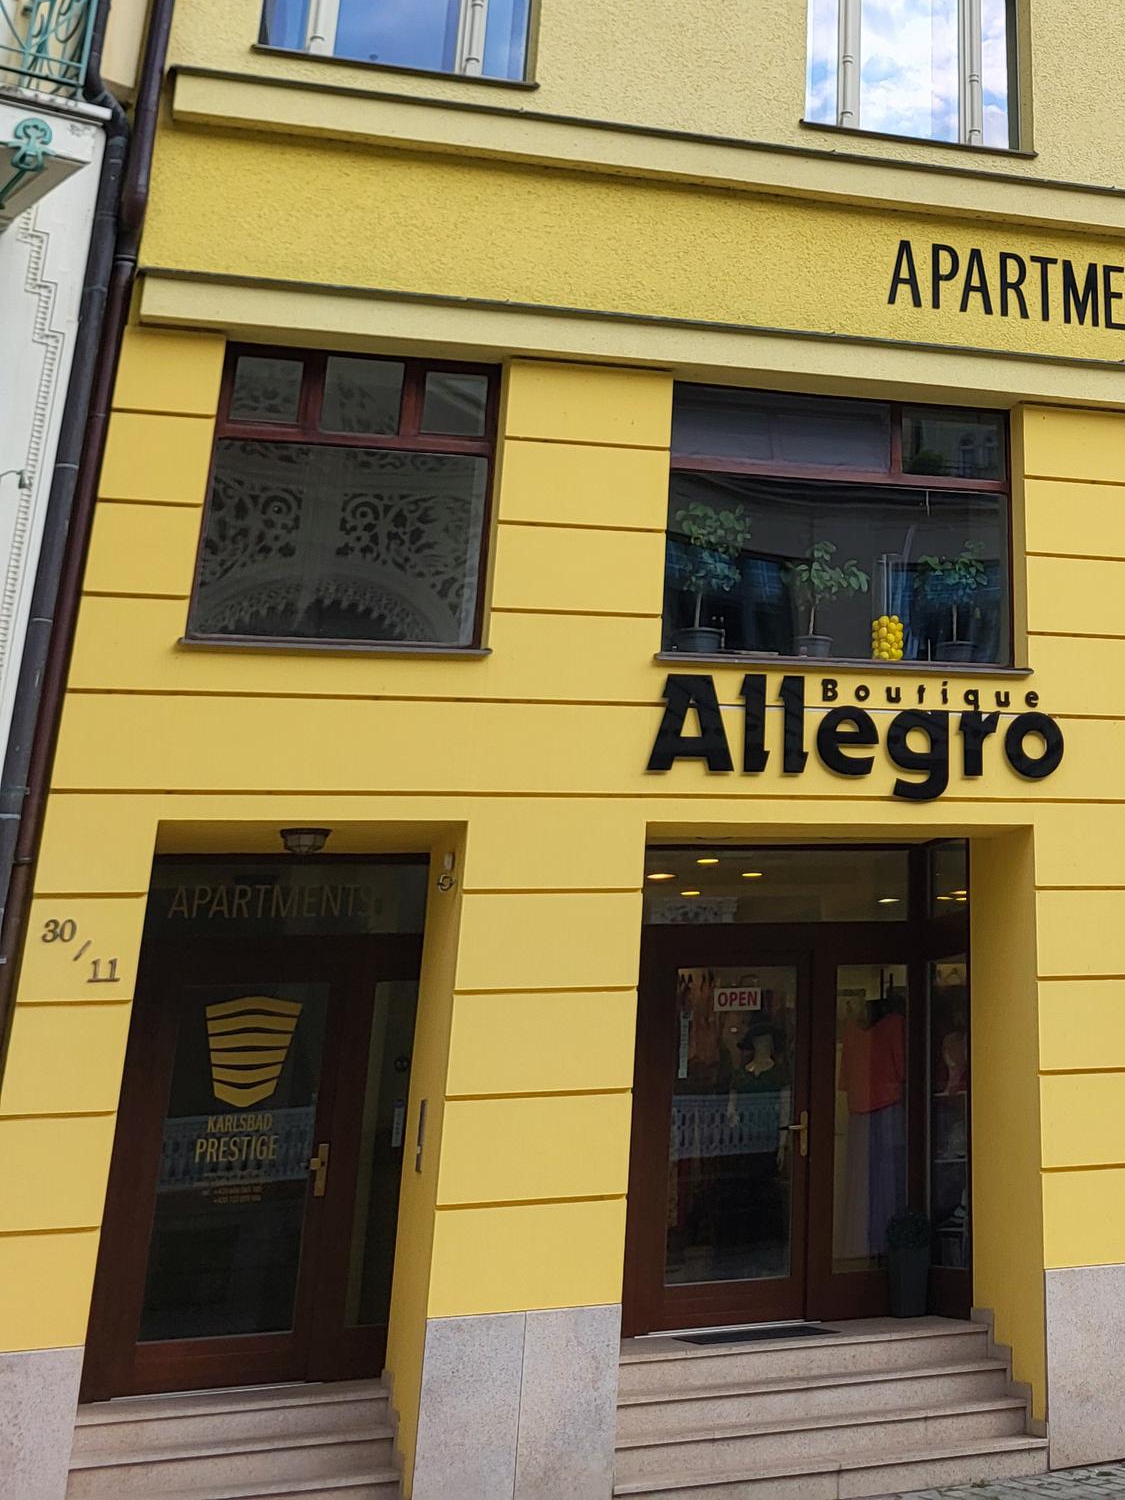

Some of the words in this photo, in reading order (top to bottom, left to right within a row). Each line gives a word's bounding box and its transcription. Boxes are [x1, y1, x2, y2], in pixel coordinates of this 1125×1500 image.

[821, 678, 1040, 710] Boutique
[647, 673, 1064, 800] Allegro
[168, 884, 376, 918] APARTMENTS
[718, 991, 757, 1007] OPEN
[207, 1113, 273, 1132] KARLSBAD
[195, 1135, 279, 1163] PRESTIGE
